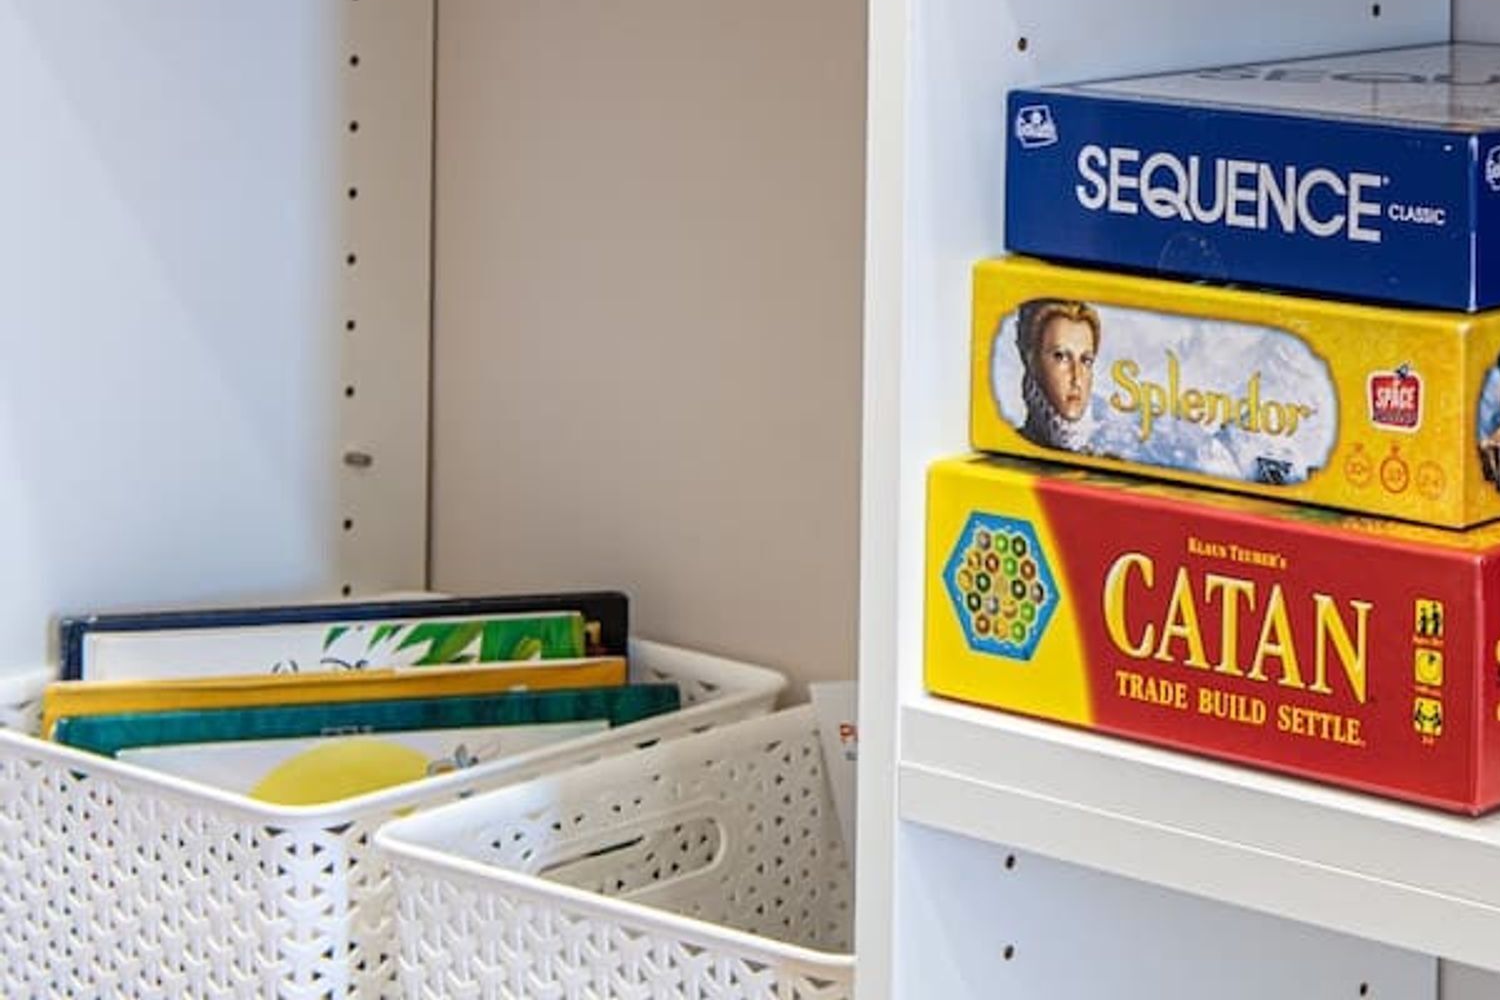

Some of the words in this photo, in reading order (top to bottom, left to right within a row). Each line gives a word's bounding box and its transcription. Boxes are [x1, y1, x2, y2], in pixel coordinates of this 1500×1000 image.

[1075, 145, 1383, 243] SEQUENCE
[1388, 201, 1446, 227] CLASSIC
[1108, 345, 1312, 443] Splendor
[1375, 381, 1416, 411] SPACE
[1103, 551, 1374, 705] CATAN
[1115, 669, 1189, 709] TRADE
[1198, 689, 1268, 727] BUILD
